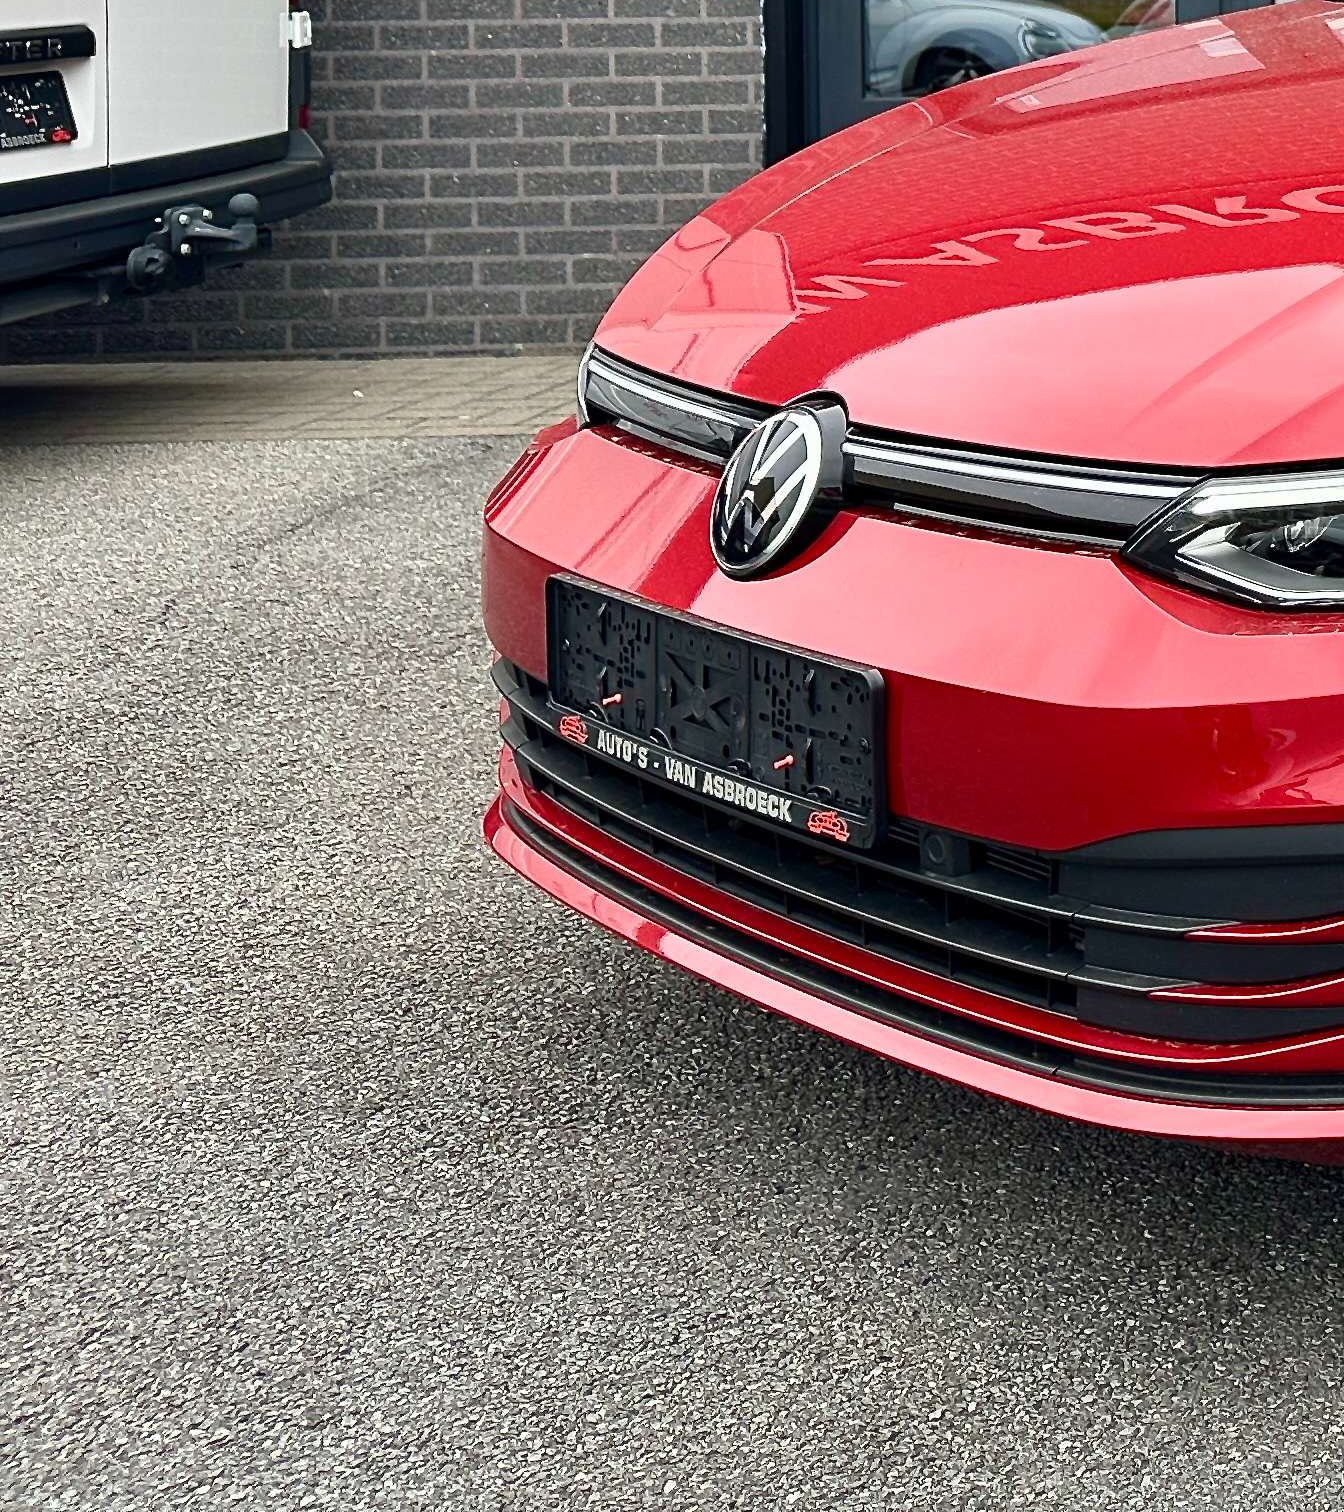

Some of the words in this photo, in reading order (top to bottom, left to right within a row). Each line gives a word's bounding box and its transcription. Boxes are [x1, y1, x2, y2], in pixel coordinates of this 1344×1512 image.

[596, 728, 648, 770] AUTO'S
[664, 755, 697, 789] VAN
[702, 771, 793, 824] ASBROECK
